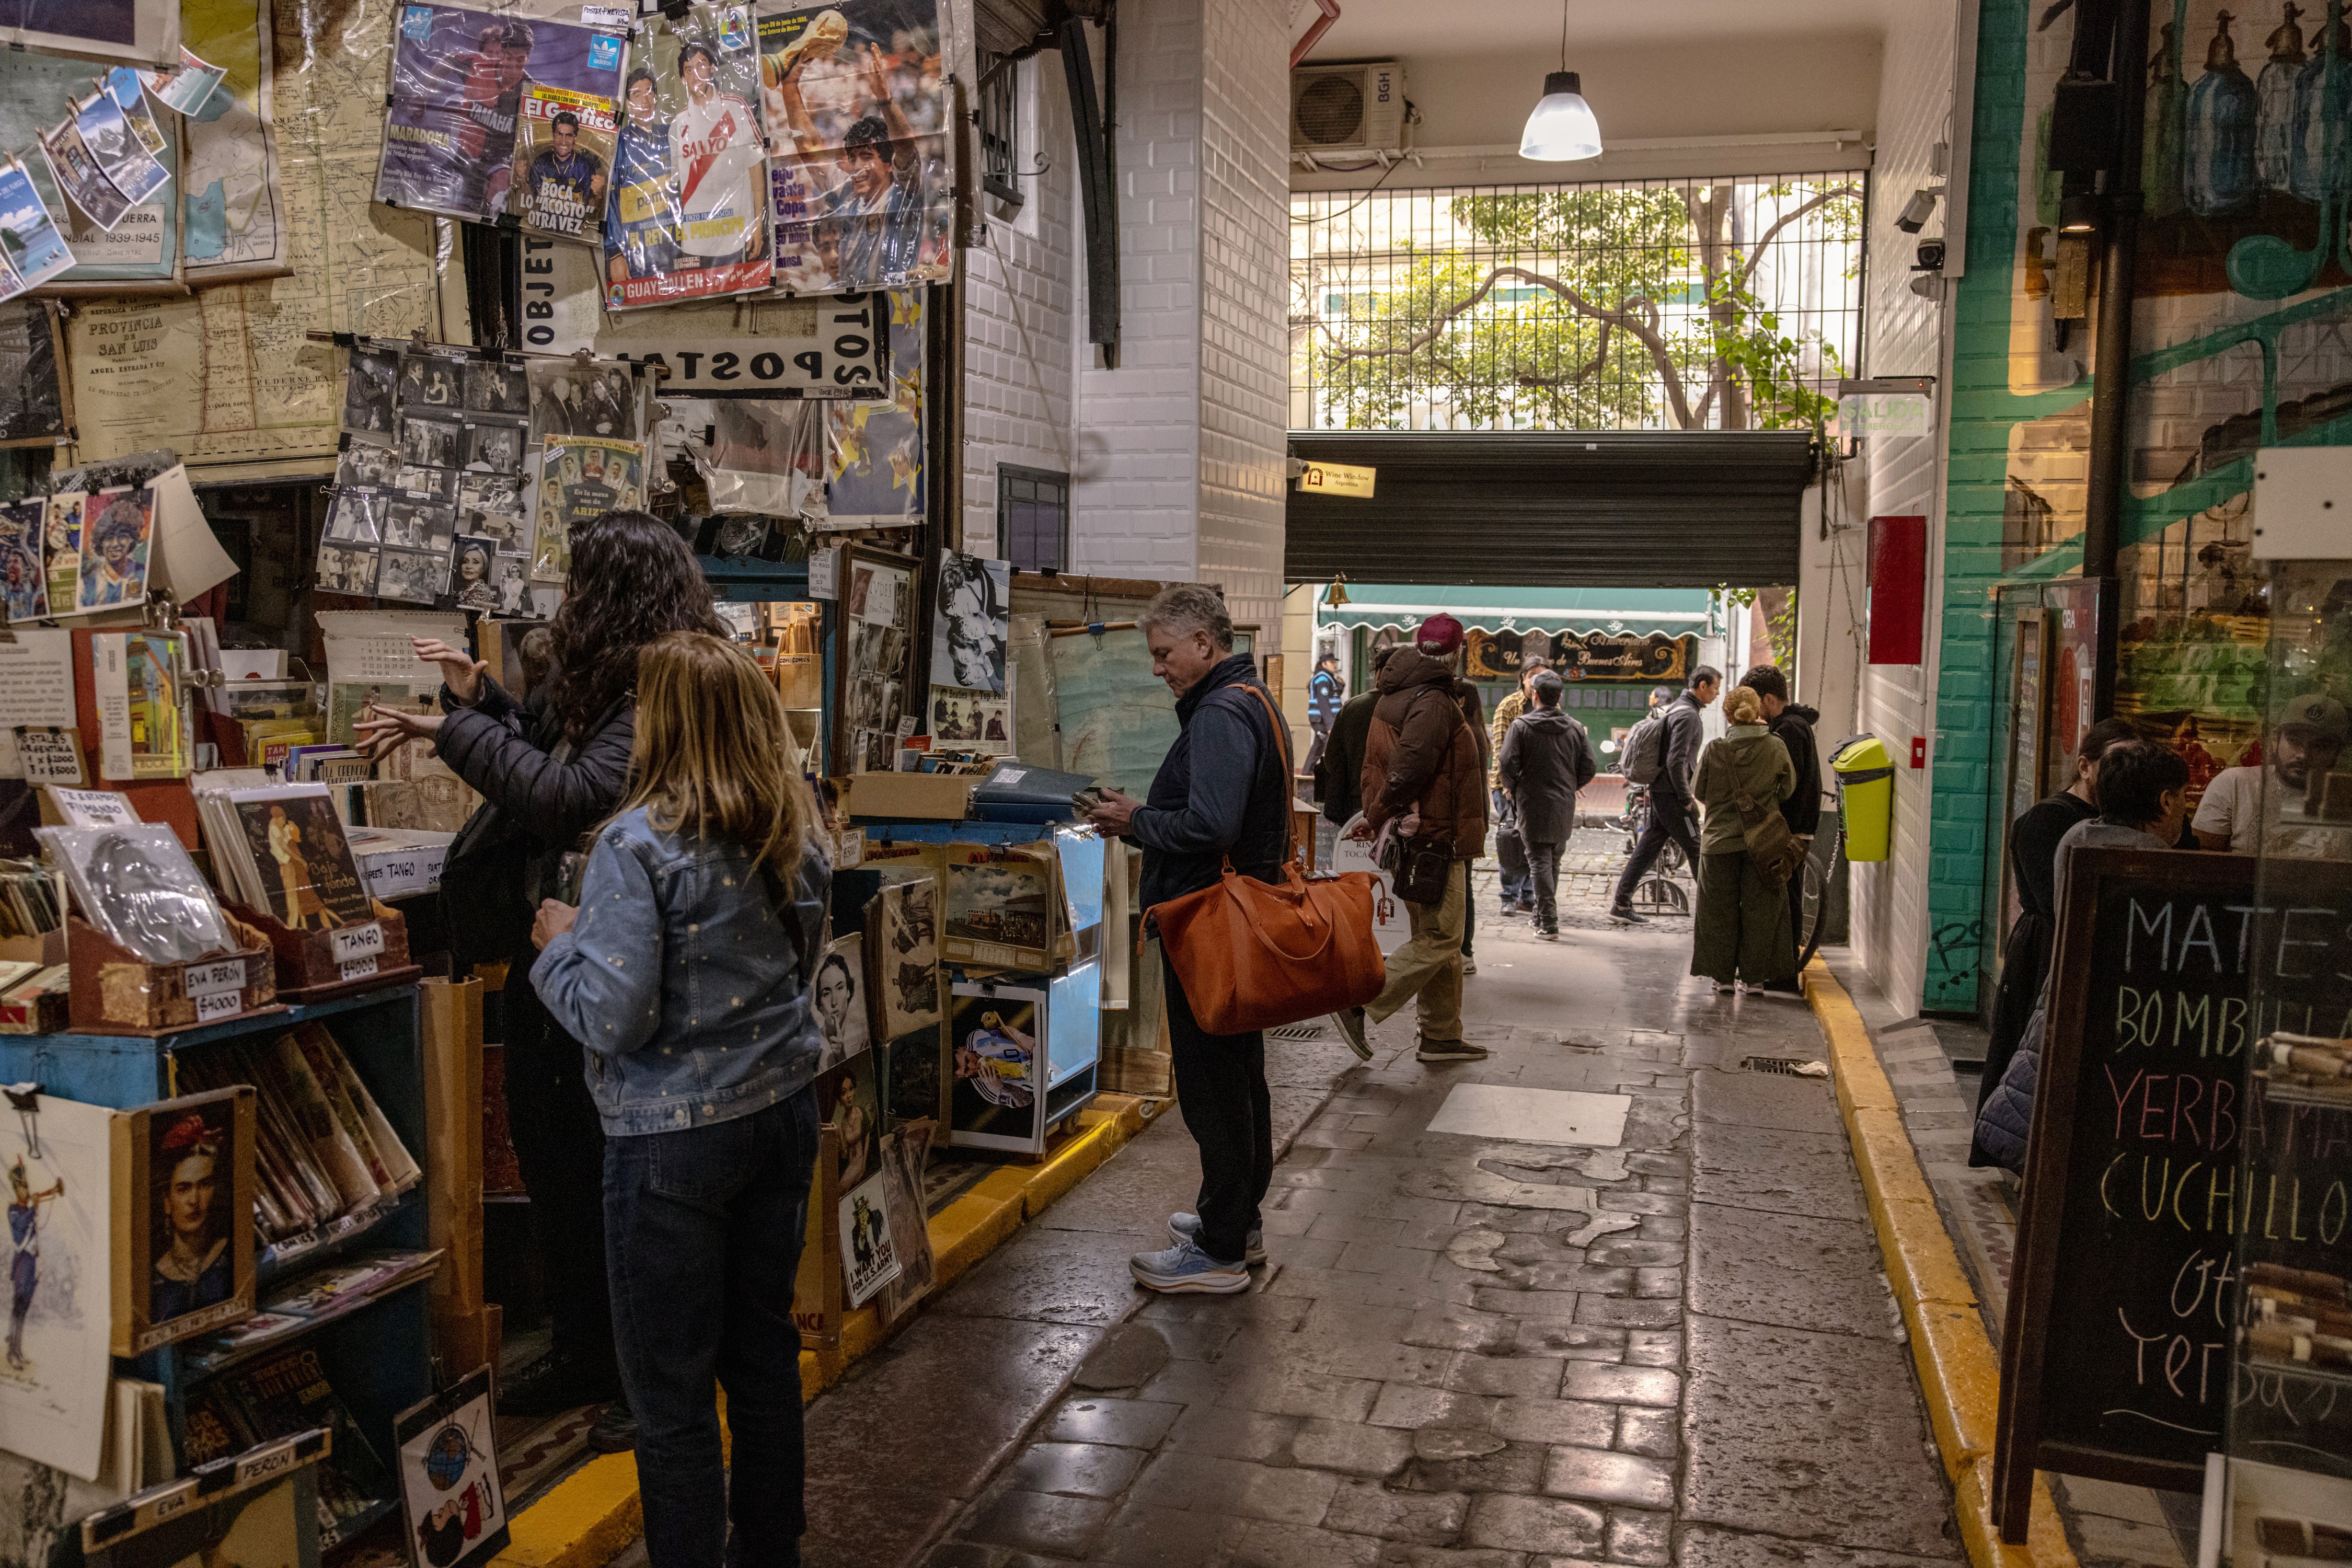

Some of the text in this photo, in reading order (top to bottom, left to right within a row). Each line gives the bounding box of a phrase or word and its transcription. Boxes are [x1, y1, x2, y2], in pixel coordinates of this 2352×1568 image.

[607, 9, 629, 17] REVISTA
[534, 85, 556, 94] MARADONA:
[584, 93, 610, 105] APASIONANTE
[548, 93, 560, 101] DIABLO
[1378, 72, 1390, 103] BGH
[524, 98, 543, 116] El
[470, 103, 513, 133] YAMAHA
[388, 124, 450, 147] MARADONA
[683, 136, 728, 158] SANYO
[520, 193, 533, 209] LO
[541, 182, 572, 201] BOCA
[776, 199, 806, 217] Copa
[528, 211, 583, 234] OTRA VEZ
[105, 233, 159, 243] 1939-1945
[629, 216, 744, 249] EL REY PRINCIPE
[525, 237, 555, 345] OBJET
[627, 272, 704, 298] GUAYMALLEN
[89, 316, 163, 336] PROVINCIA
[99, 338, 158, 356] SAN LUIS
[1343, 472, 1370, 481] Window
[1503, 651, 1520, 665] Un
[1555, 653, 1567, 666] de
[1577, 650, 1613, 667] Buenos
[1612, 652, 1643, 667] Aires
[949, 689, 1008, 701] Beatles Top Poll!
[20, 744, 72, 753] ARGENTINA
[267, 746, 285, 755] TAN
[49, 766, 77, 777] $5000
[326, 765, 367, 778] LA CRENCHA
[61, 790, 118, 802] TE ESTAMOS
[66, 802, 122, 814] FILMANDO
[843, 832, 859, 845] OFERTA
[387, 862, 414, 878] TANGO
[325, 874, 356, 894] fondo
[340, 929, 379, 952] TANGO
[188, 963, 240, 988] EVA PERÓN
[199, 994, 237, 1017] $4000
[849, 1238, 892, 1284] I WANT YOU
[852, 1251, 893, 1294] FOR U.S. ARMY
[857, 1264, 893, 1296] NEAREST RECRUITING STATION
[158, 1452, 291, 1515] EVA PERON
